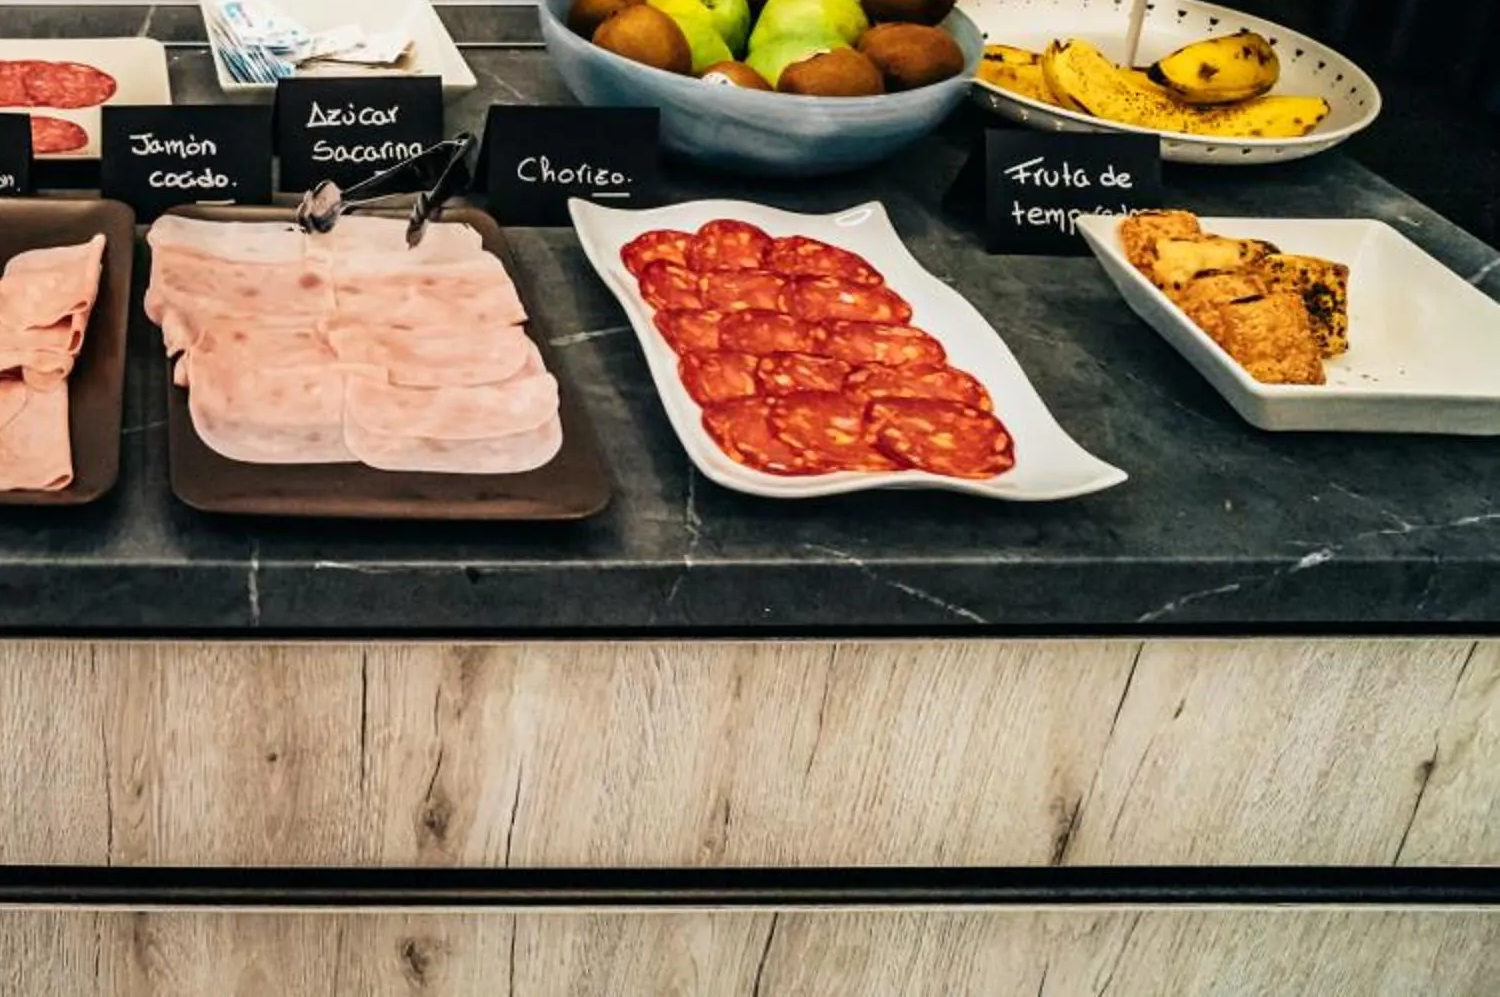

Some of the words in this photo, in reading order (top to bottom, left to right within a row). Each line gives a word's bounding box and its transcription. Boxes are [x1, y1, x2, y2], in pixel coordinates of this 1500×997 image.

[311, 140, 422, 162] Sacarina
[1004, 156, 1091, 188] Fruta
[1100, 164, 1133, 189] de
